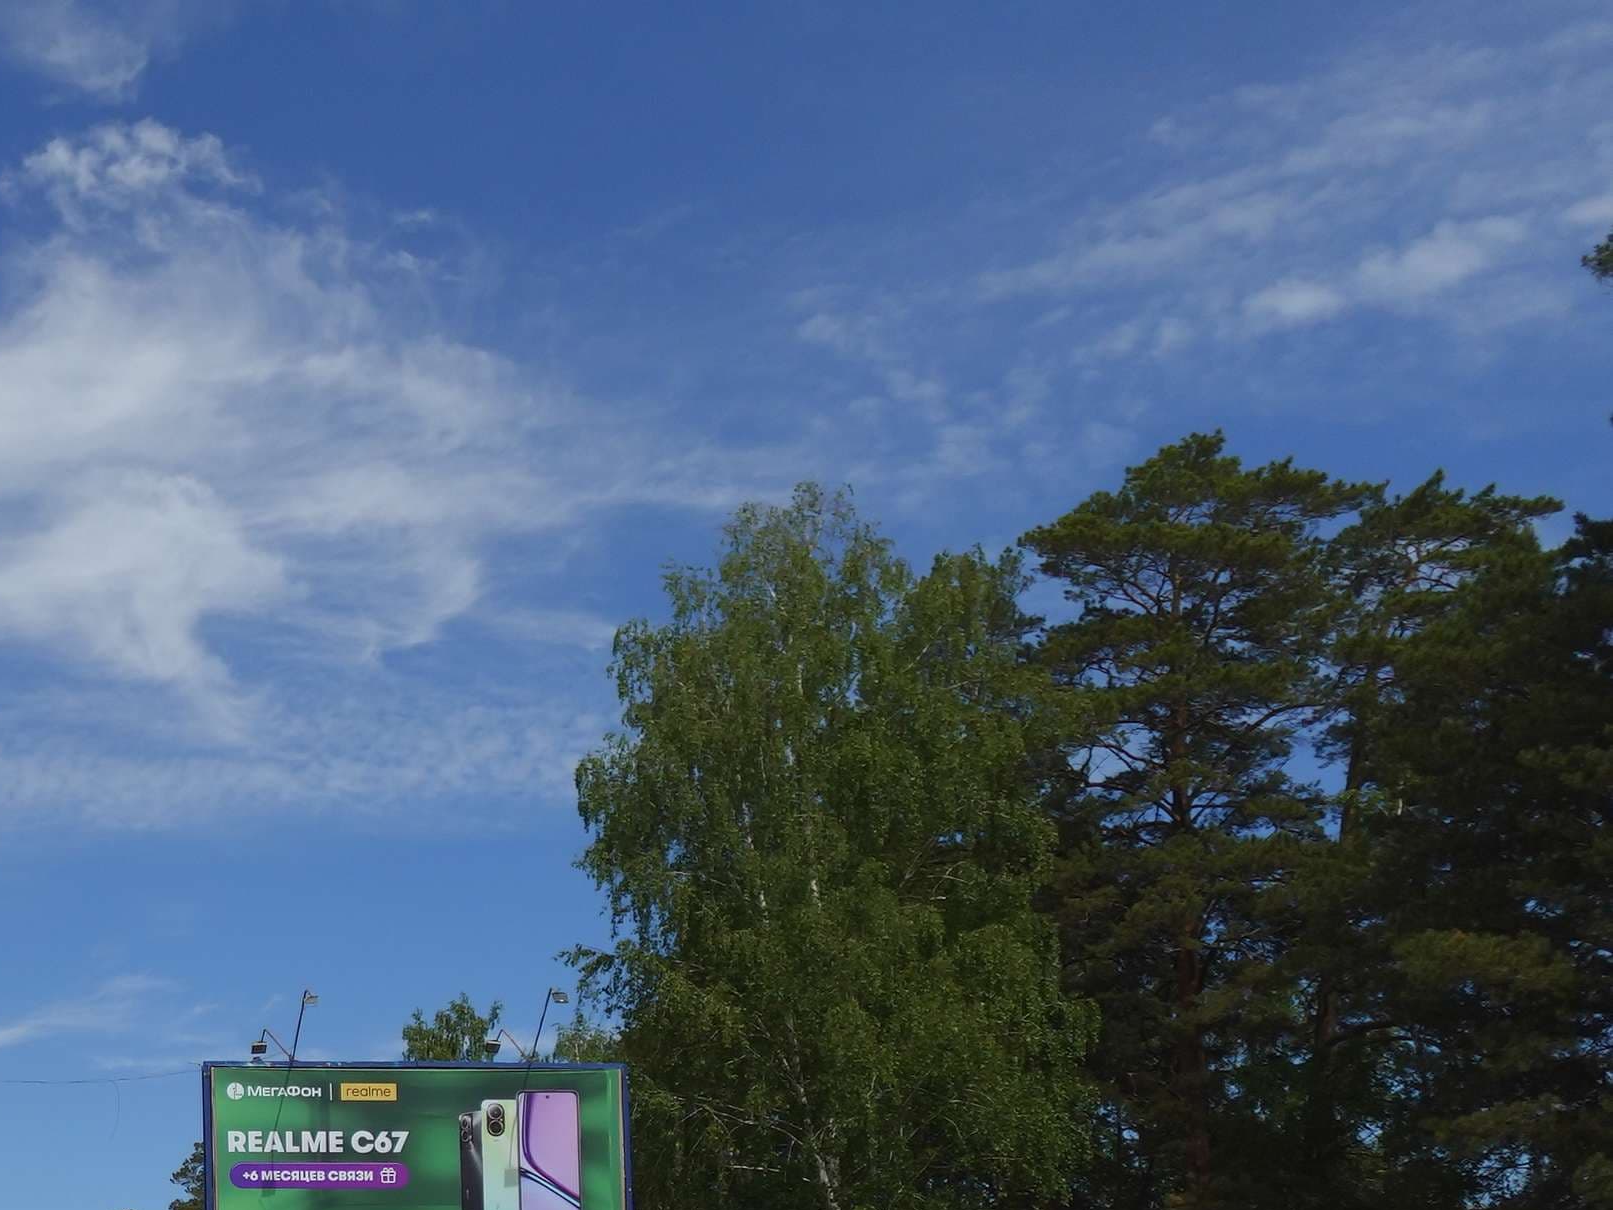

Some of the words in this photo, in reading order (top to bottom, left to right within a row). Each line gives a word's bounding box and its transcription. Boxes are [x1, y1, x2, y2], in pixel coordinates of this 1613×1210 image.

[346, 1086, 391, 1097] realme
[227, 1130, 343, 1153] REALME
[351, 1130, 410, 1154] C67
[242, 1171, 259, 1181] +6
[261, 1170, 326, 1182] МЕСЯЦЕВ
[328, 1170, 374, 1182] СВЯЗИ
